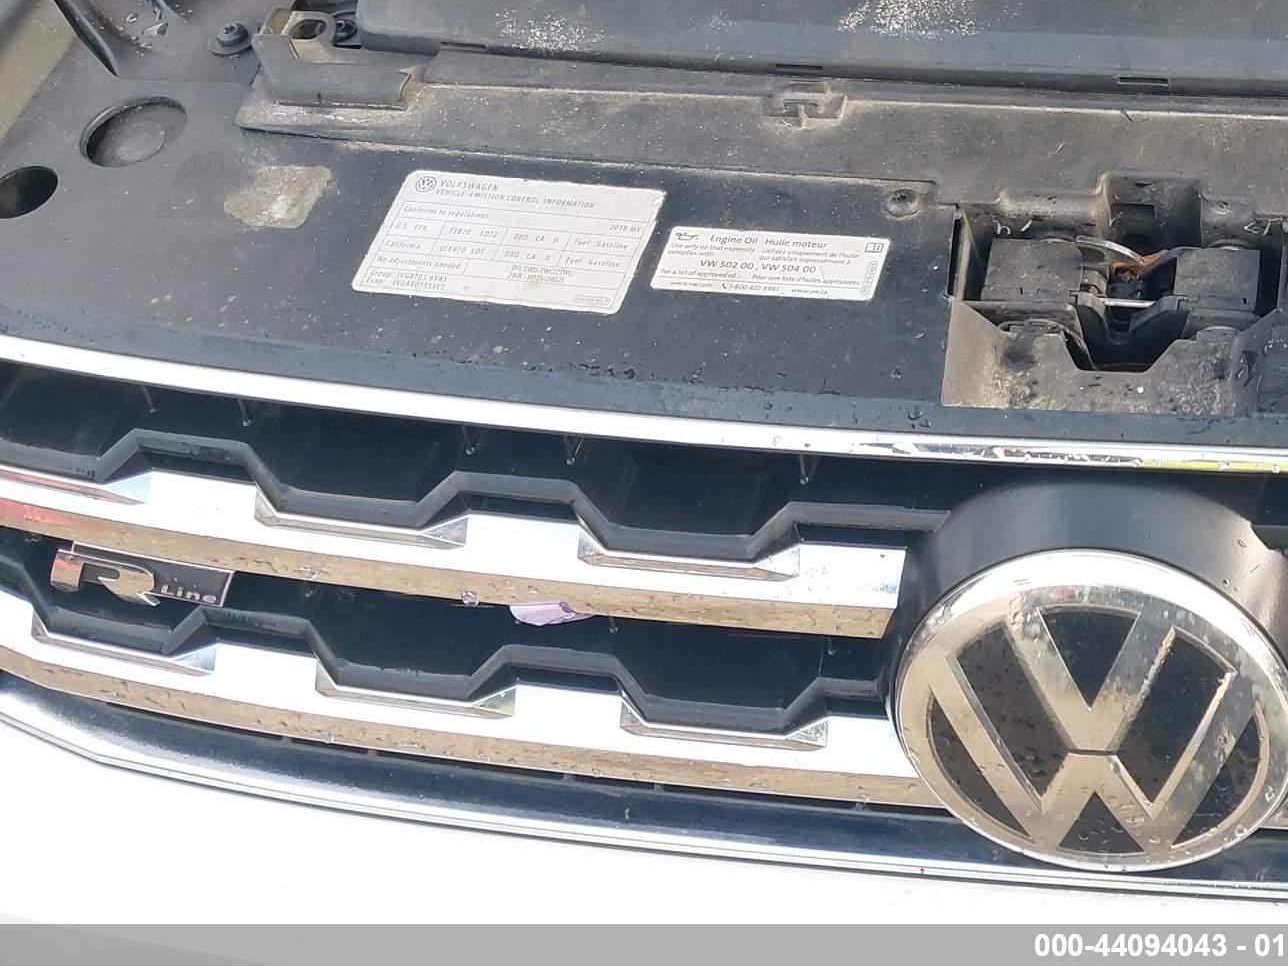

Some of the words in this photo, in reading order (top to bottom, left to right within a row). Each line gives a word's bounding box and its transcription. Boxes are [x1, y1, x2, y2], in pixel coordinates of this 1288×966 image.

[437, 179, 500, 191] VOLKSWAGEN
[434, 188, 466, 197] VEHICLE
[468, 191, 506, 200] EMISSION
[505, 193, 540, 203] CONTROL
[543, 196, 596, 207] INFORMATION
[708, 234, 743, 245] Engine
[743, 236, 758, 244] Oil
[764, 238, 791, 246] Huile
[791, 240, 828, 248] moteur
[699, 259, 718, 267] VW
[719, 260, 738, 268] 502
[760, 262, 780, 270] VW
[780, 264, 800, 272] 504
[801, 265, 817, 273] 00
[50, 549, 161, 607] R
